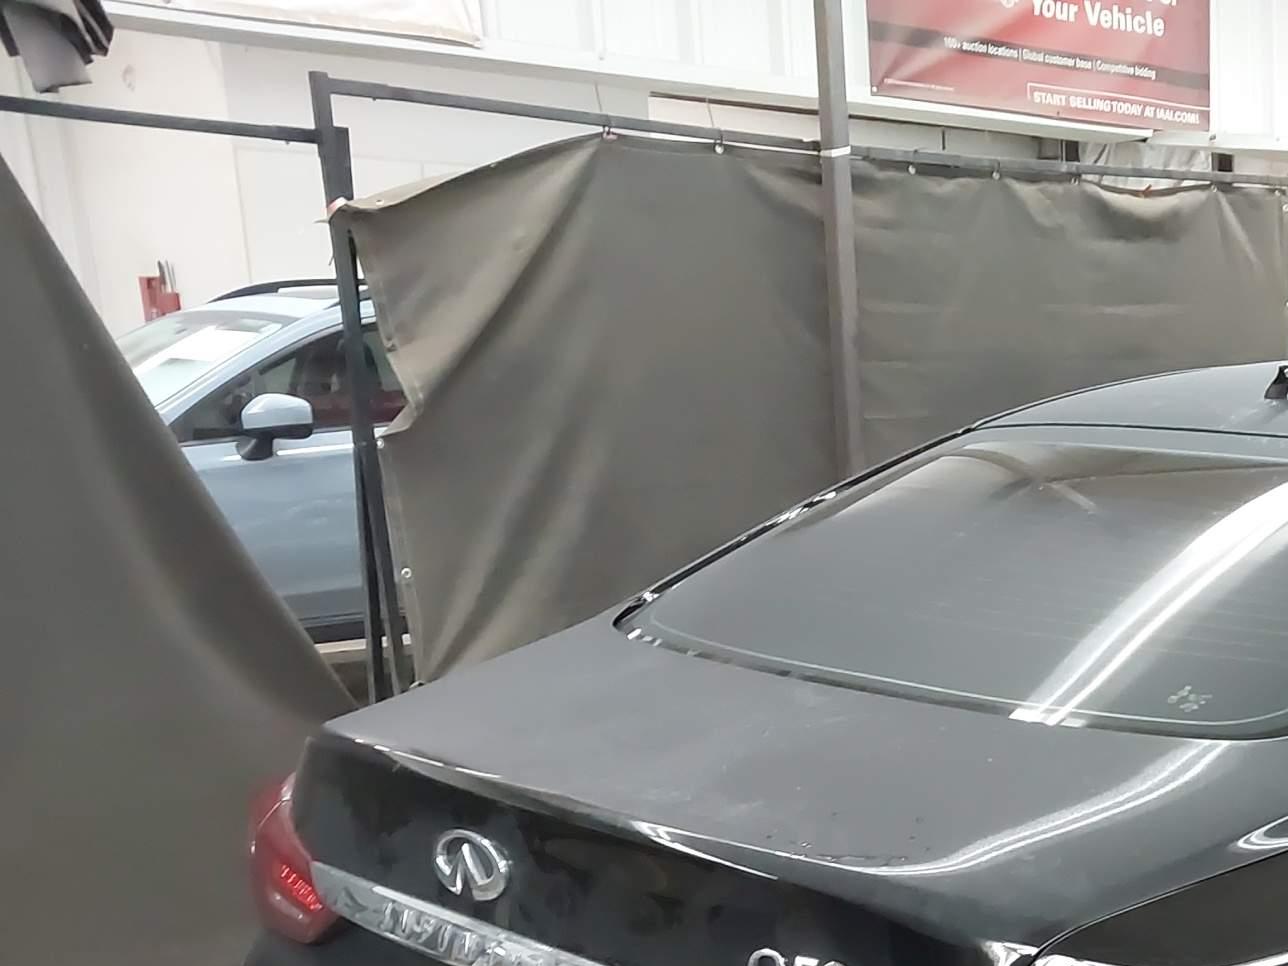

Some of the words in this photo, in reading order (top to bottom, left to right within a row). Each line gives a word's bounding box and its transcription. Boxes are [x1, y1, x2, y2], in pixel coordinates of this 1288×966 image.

[1032, 0, 1078, 23] Your
[1084, 0, 1166, 37] Vehicle
[1033, 91, 1068, 106] START
[1143, 105, 1156, 119] AT
